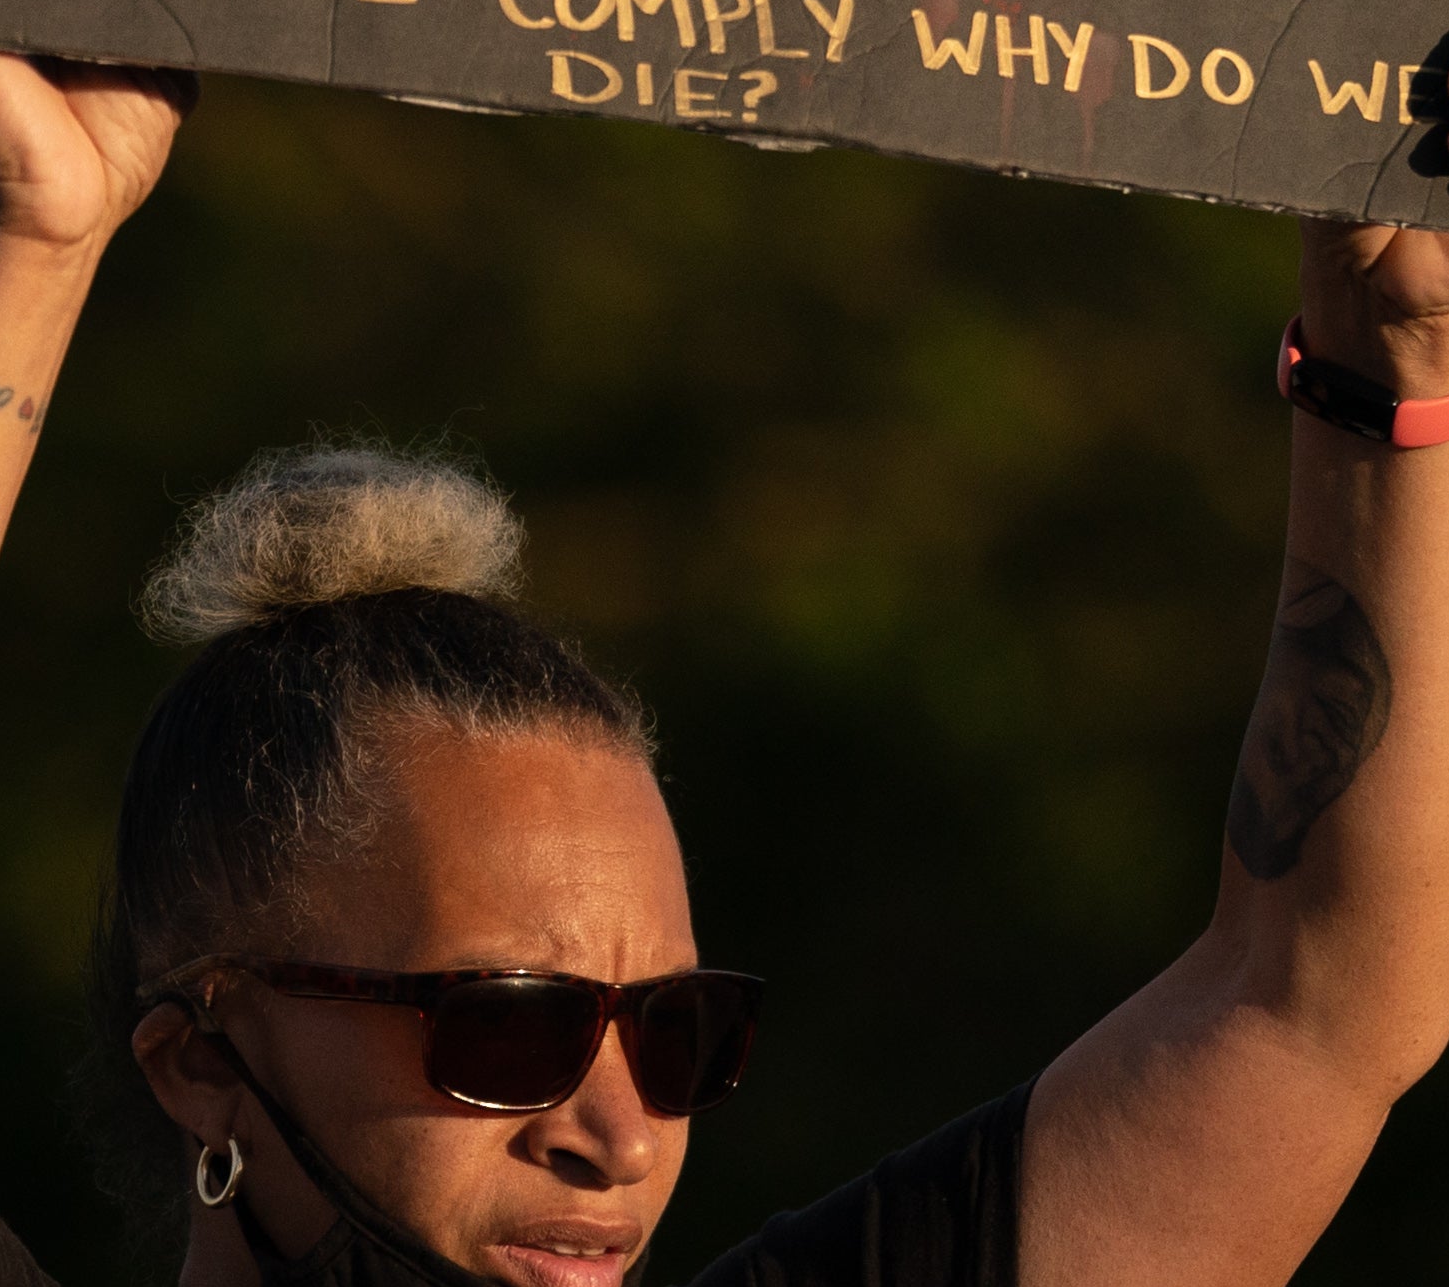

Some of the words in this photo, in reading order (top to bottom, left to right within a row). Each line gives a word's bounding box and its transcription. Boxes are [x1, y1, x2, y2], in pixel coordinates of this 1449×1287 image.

[546, 50, 778, 123] DIE?
[911, 9, 1095, 92] WHY
[1128, 34, 1255, 106] DO
[1308, 60, 1449, 125] WE
